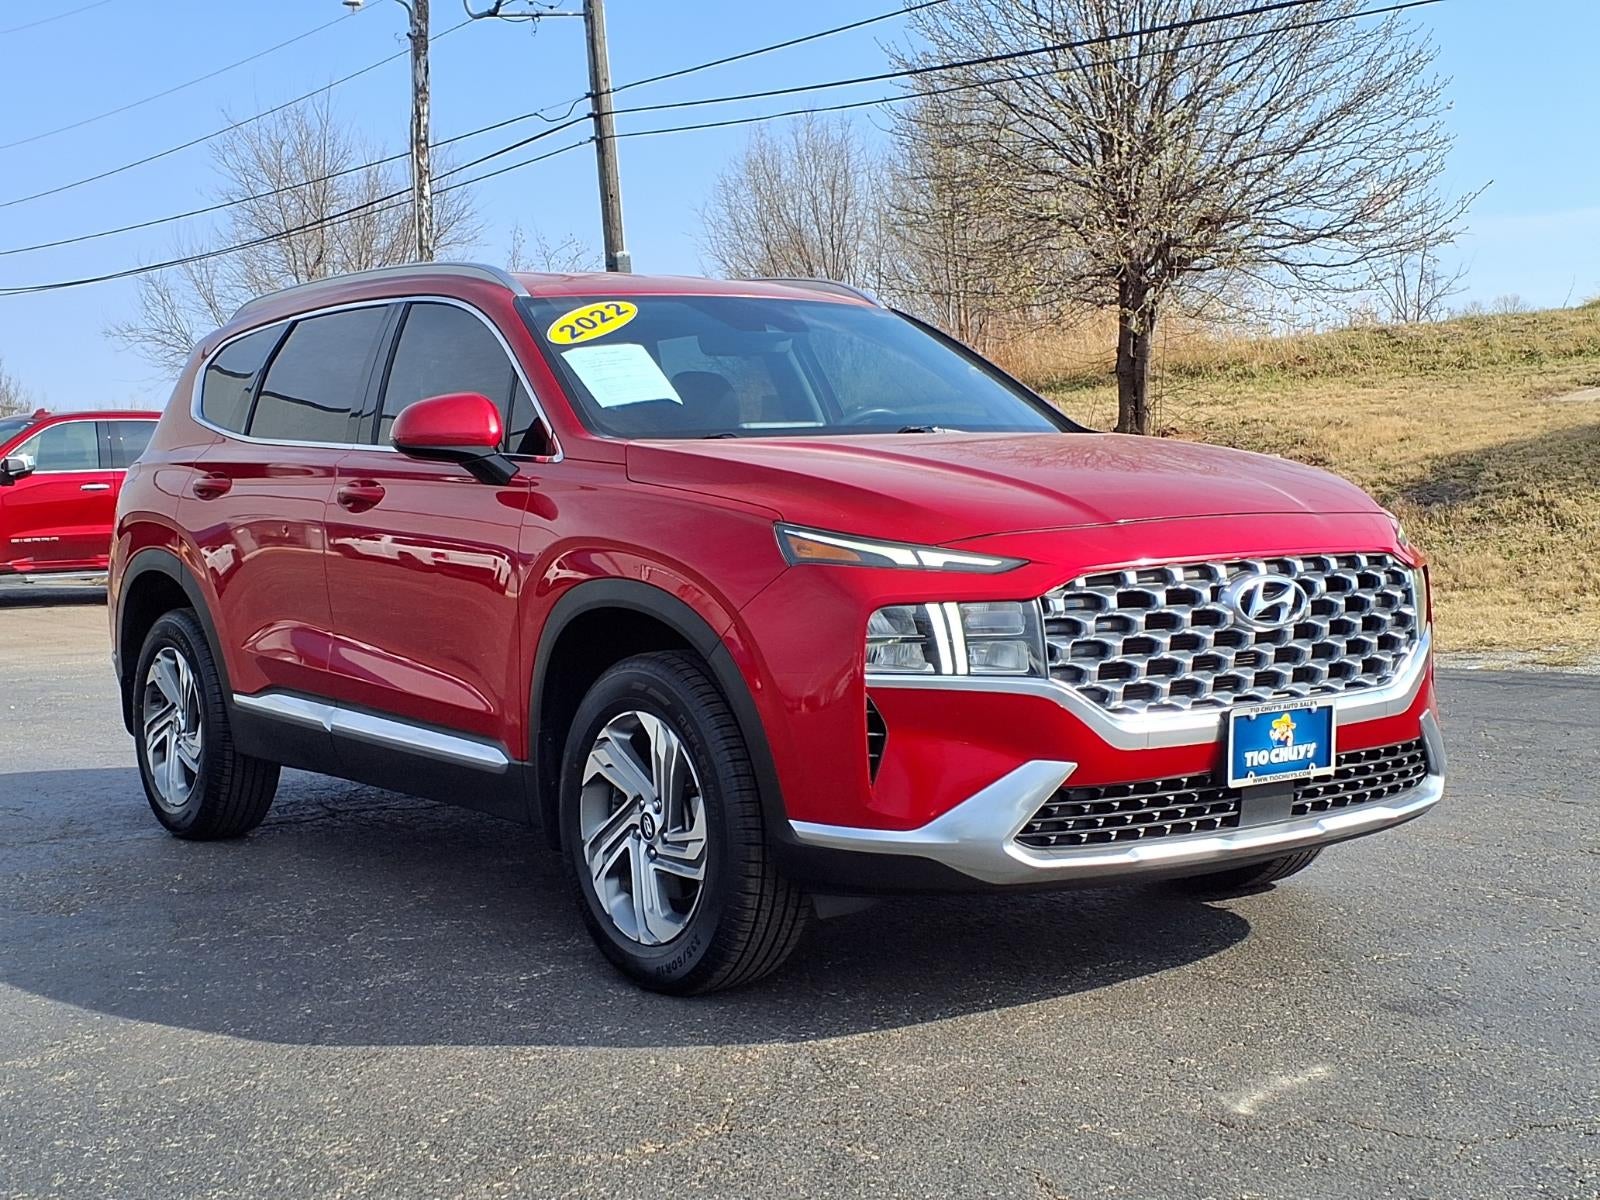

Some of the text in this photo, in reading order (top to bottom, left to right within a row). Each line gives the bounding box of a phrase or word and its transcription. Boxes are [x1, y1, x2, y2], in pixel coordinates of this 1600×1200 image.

[559, 303, 629, 340] 2022
[1300, 700, 1318, 708] SALES
[1244, 742, 1317, 767] TIO CHUY'S
